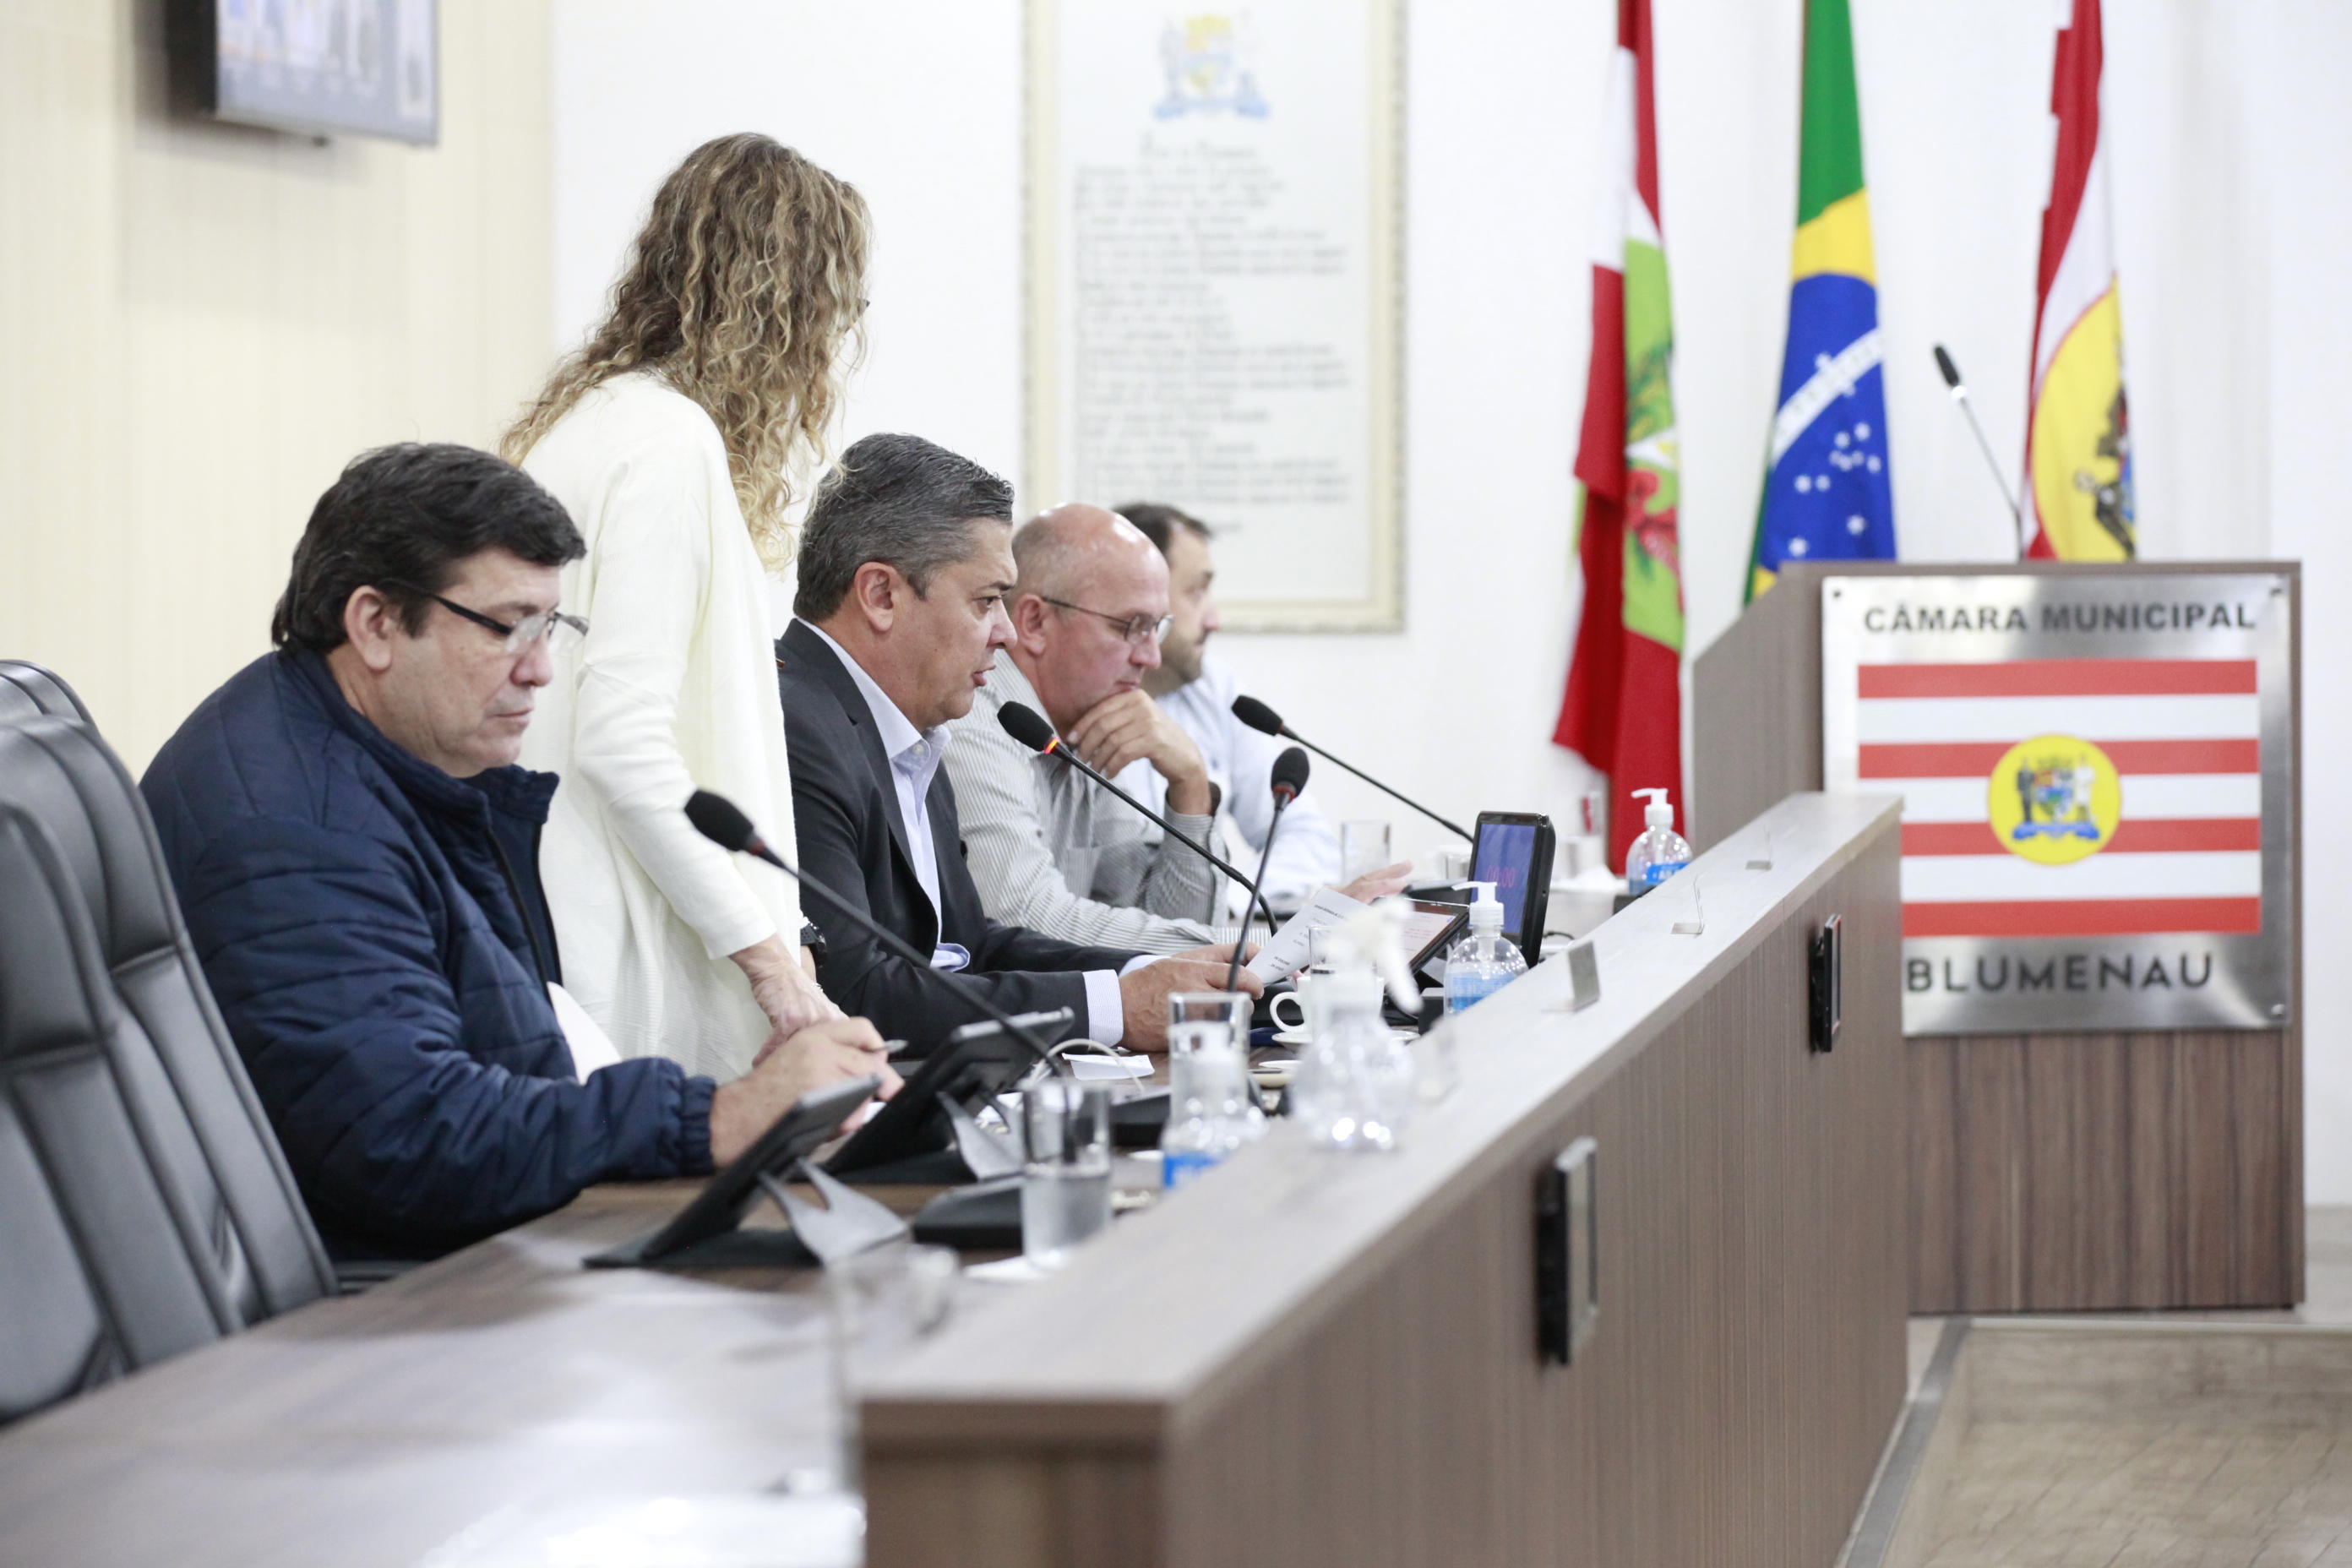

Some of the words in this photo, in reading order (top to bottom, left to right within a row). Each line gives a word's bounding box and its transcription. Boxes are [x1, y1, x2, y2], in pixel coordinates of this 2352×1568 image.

[1865, 601, 2028, 632] CÂMARA
[2041, 601, 2257, 632] MUNICIPAL
[1907, 953, 2212, 992] BLUMENAU
